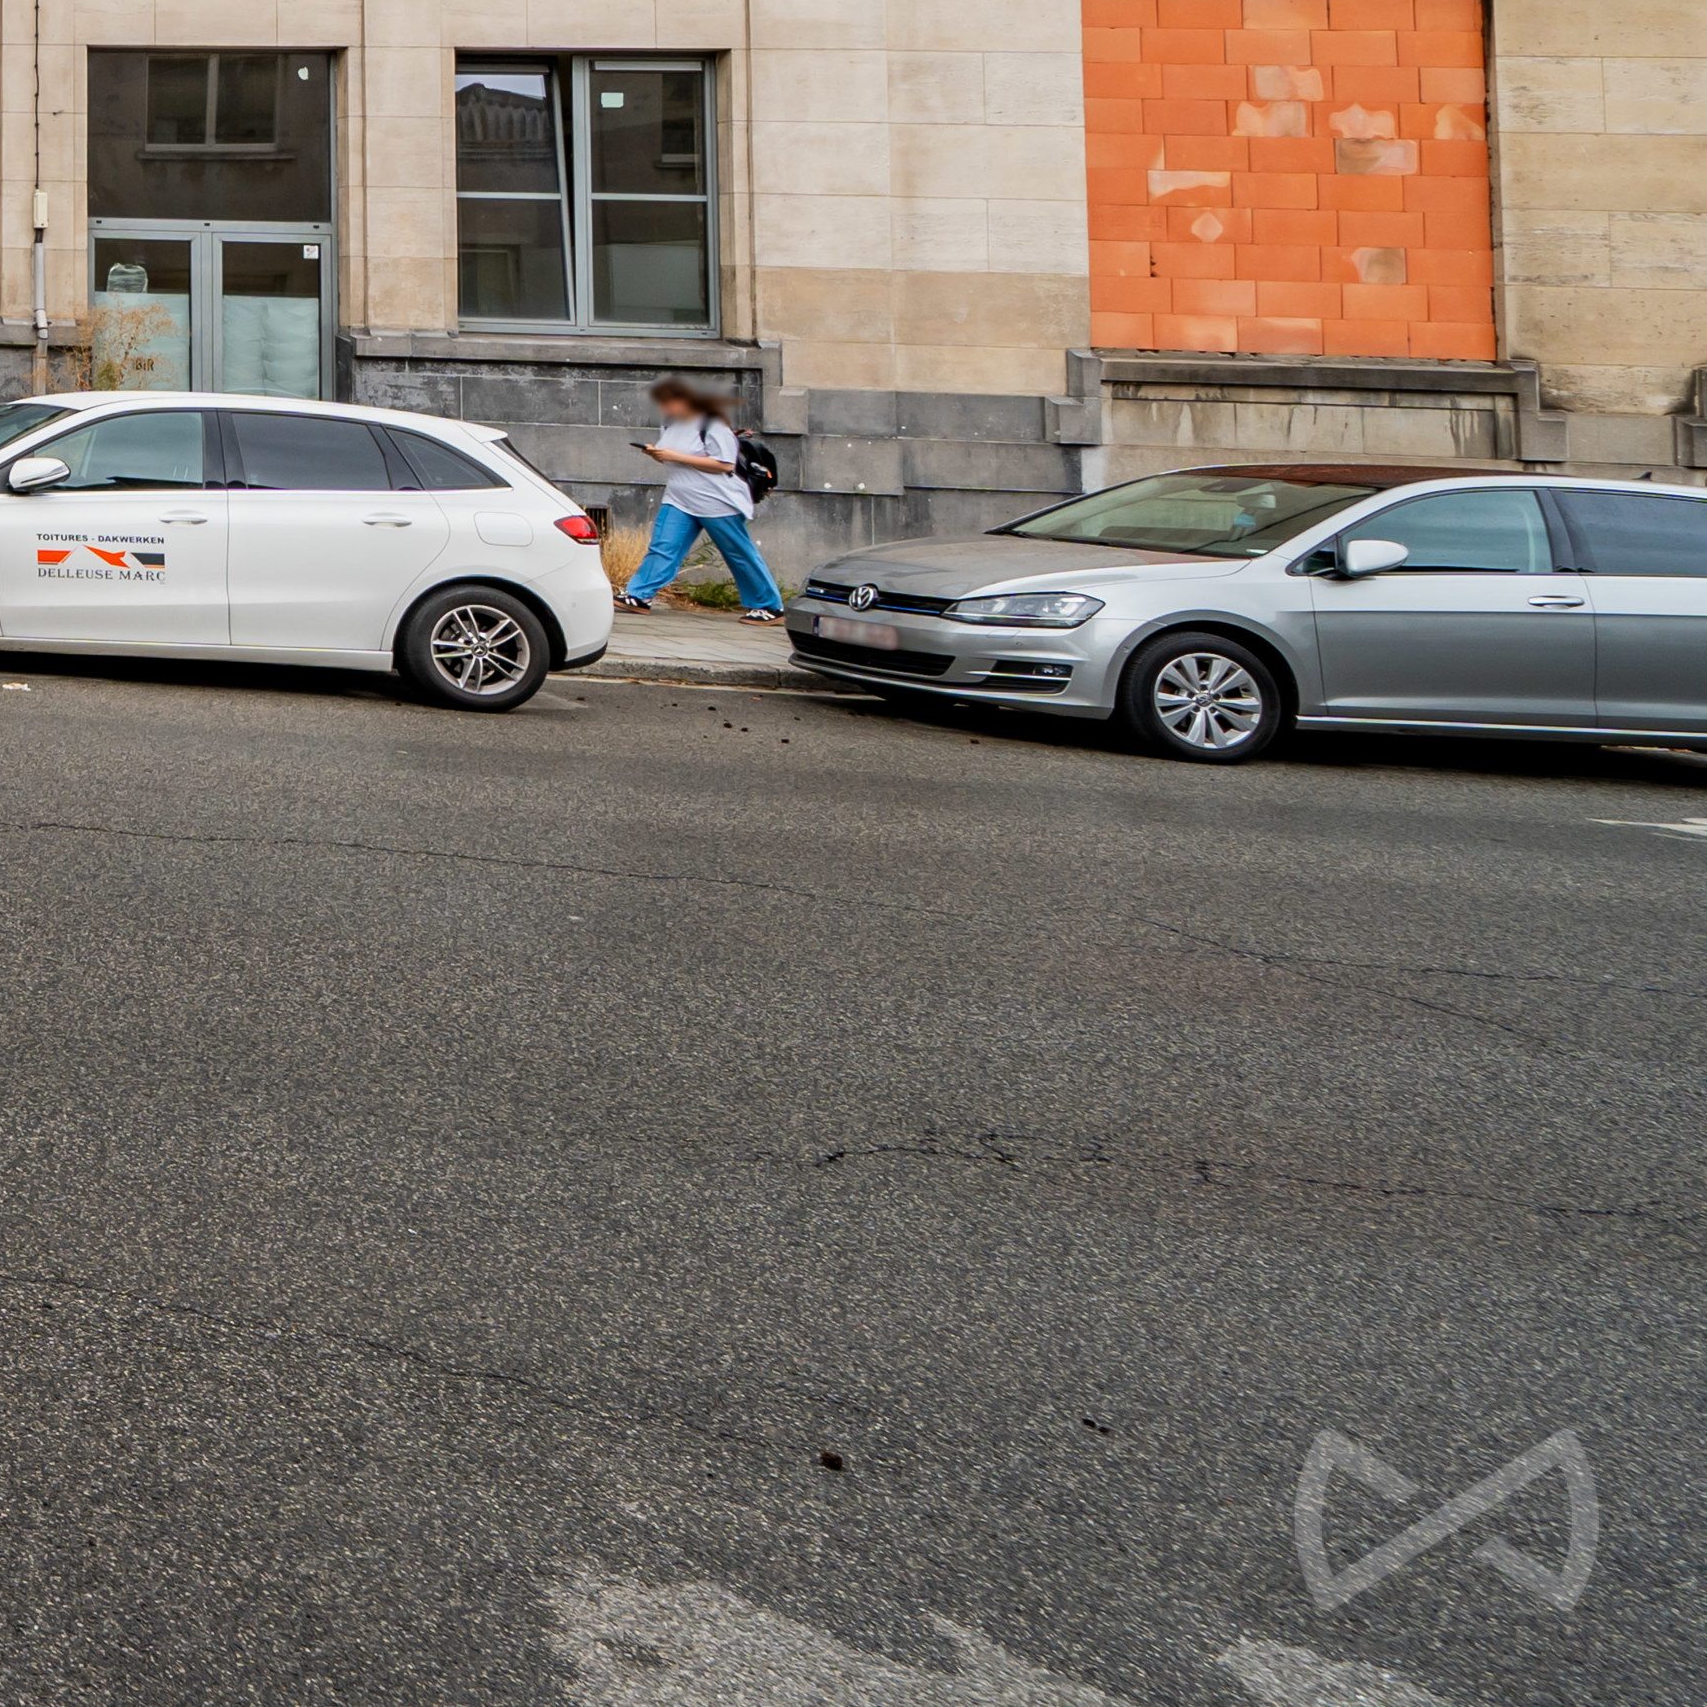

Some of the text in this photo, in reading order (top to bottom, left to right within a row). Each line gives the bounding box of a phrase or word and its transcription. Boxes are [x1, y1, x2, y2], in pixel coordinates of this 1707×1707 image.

[37, 533, 88, 542] TOITURES
[98, 535, 165, 544] DAKWERKEN
[38, 568, 165, 582] DELLEUSE MARC
